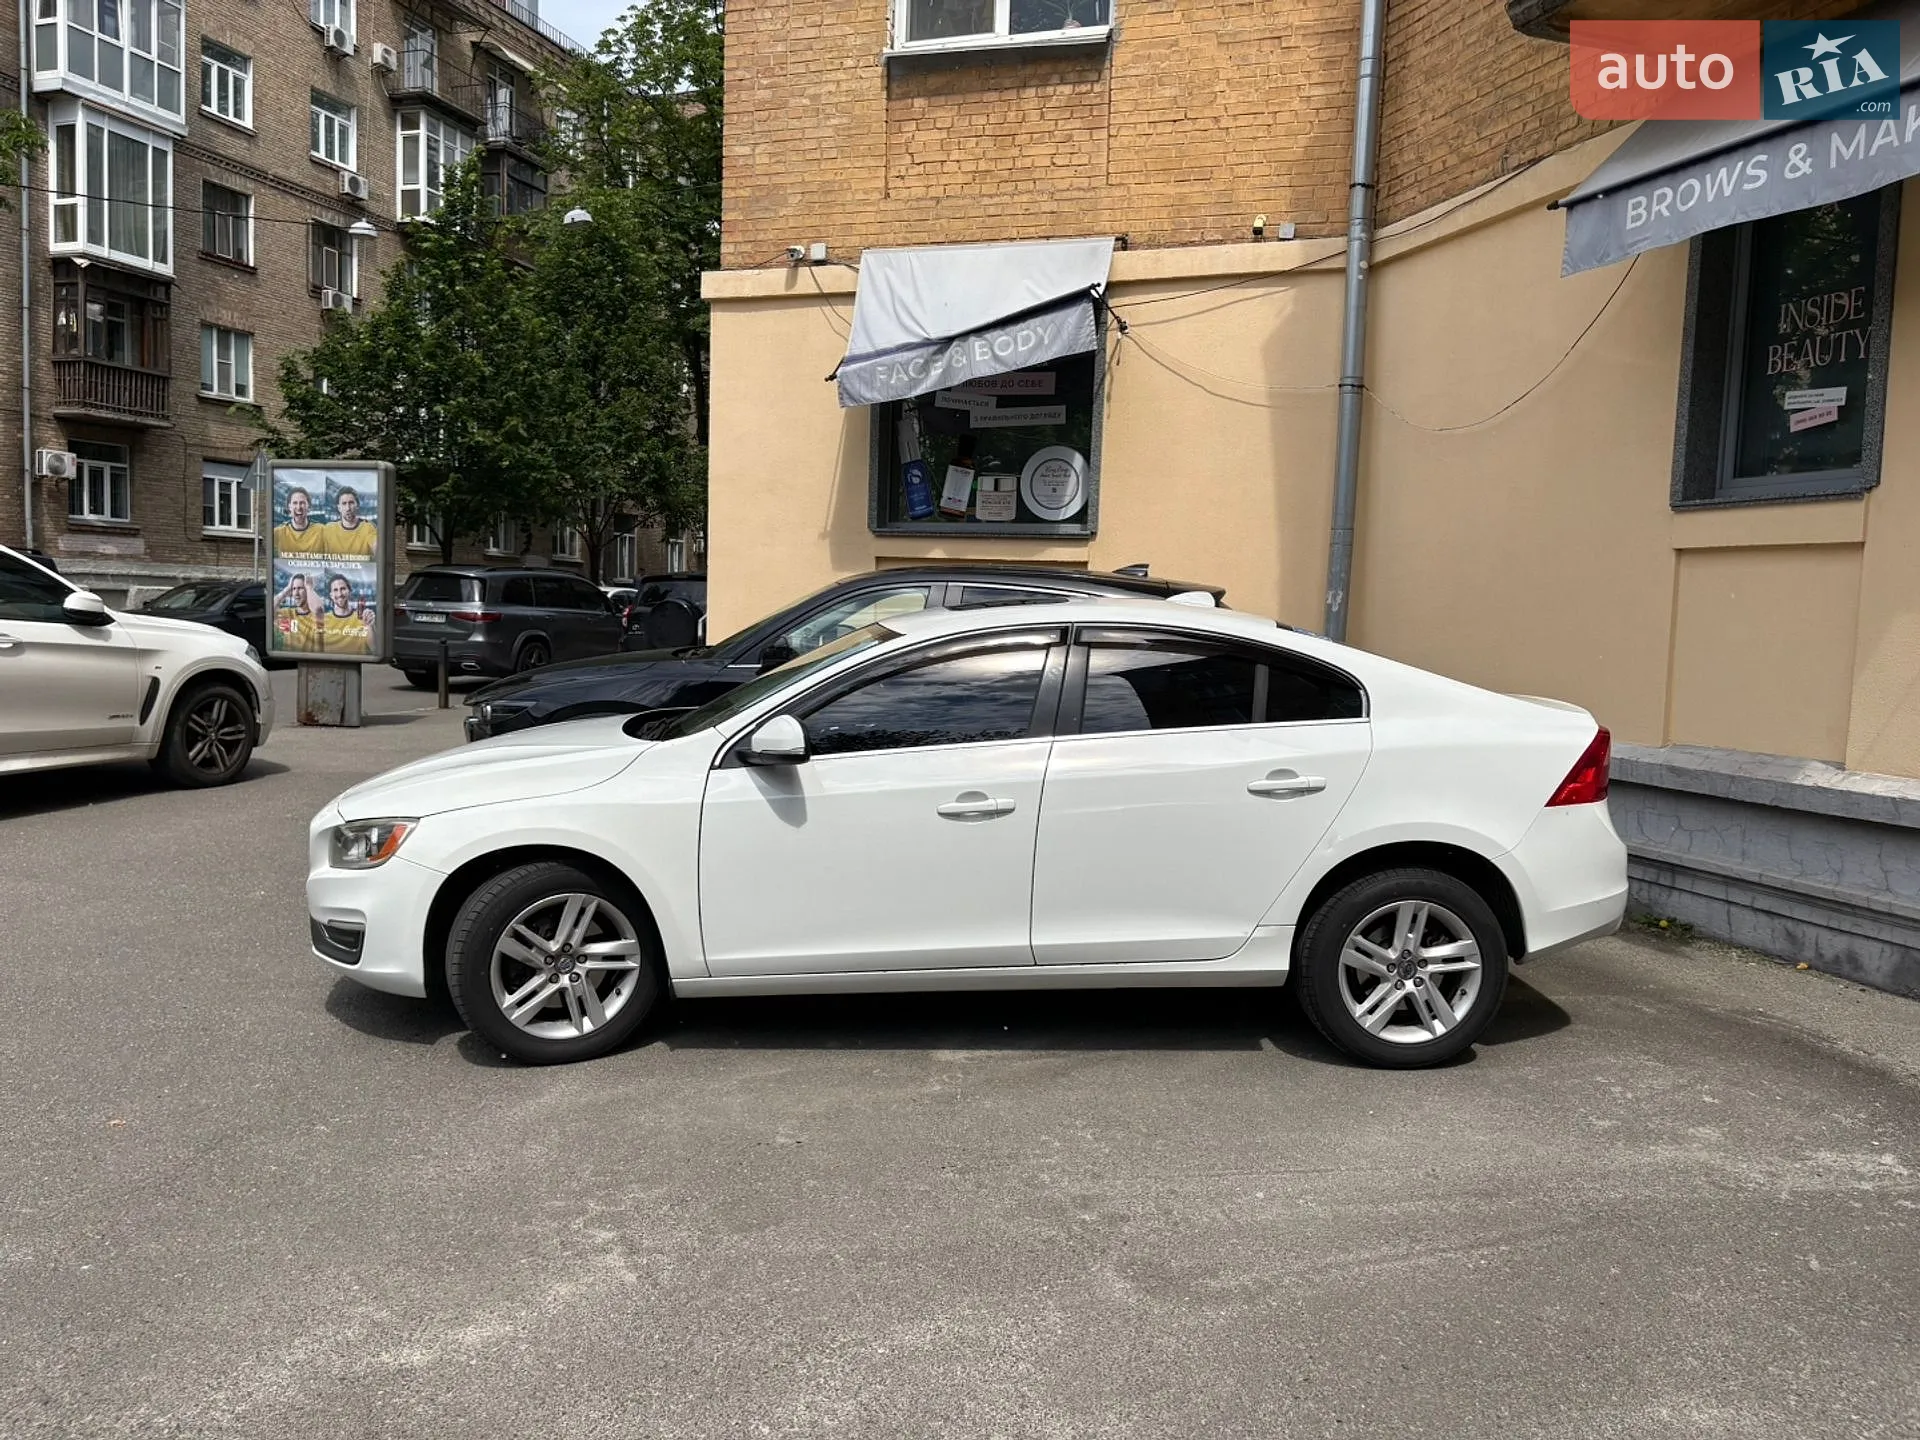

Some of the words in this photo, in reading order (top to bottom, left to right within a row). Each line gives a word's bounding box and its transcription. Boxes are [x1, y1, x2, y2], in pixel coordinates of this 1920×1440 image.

[1626, 154, 1768, 230] BROWS
[1784, 142, 1813, 180] &
[1778, 286, 1866, 335] INSIDE
[950, 346, 968, 369] &
[974, 324, 1056, 361] BODY
[1766, 327, 1872, 375] BEAUTY
